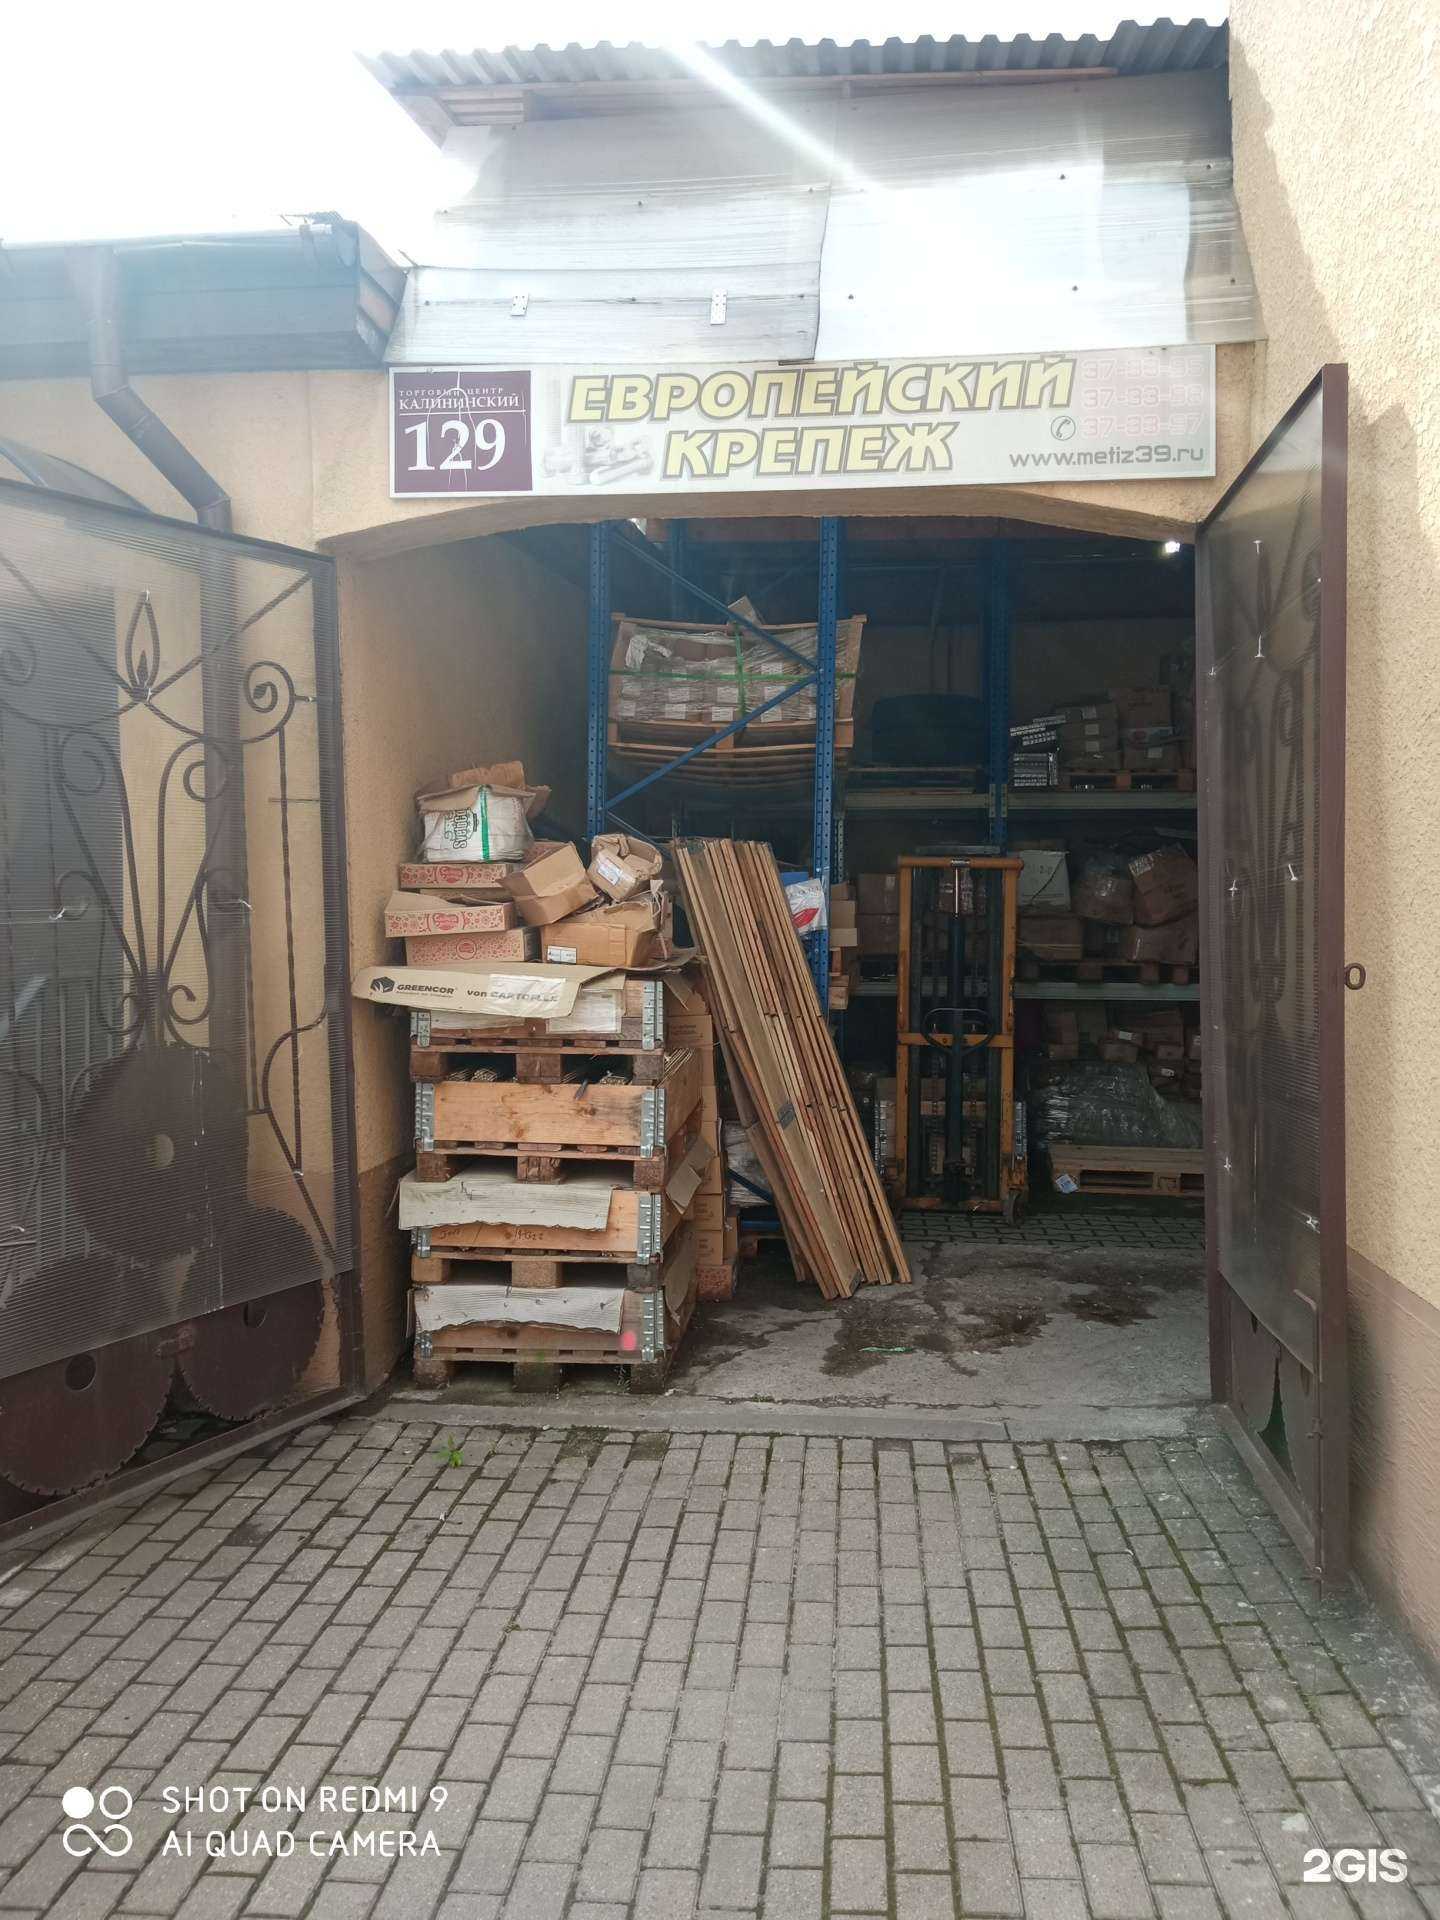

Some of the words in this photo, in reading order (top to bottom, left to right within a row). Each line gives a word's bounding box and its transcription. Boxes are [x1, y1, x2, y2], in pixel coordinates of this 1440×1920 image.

[467, 387, 504, 396] ЦЕНТР
[567, 354, 1077, 424] ЕВРОПЕЙСКИЙ
[399, 394, 519, 410] КАЛИНИНСКИЙ
[404, 418, 506, 472] 129
[662, 421, 960, 481] КРЕПЕЖ
[1009, 445, 1204, 468] www.metiz39.ru
[396, 983, 455, 995] GREENCOR
